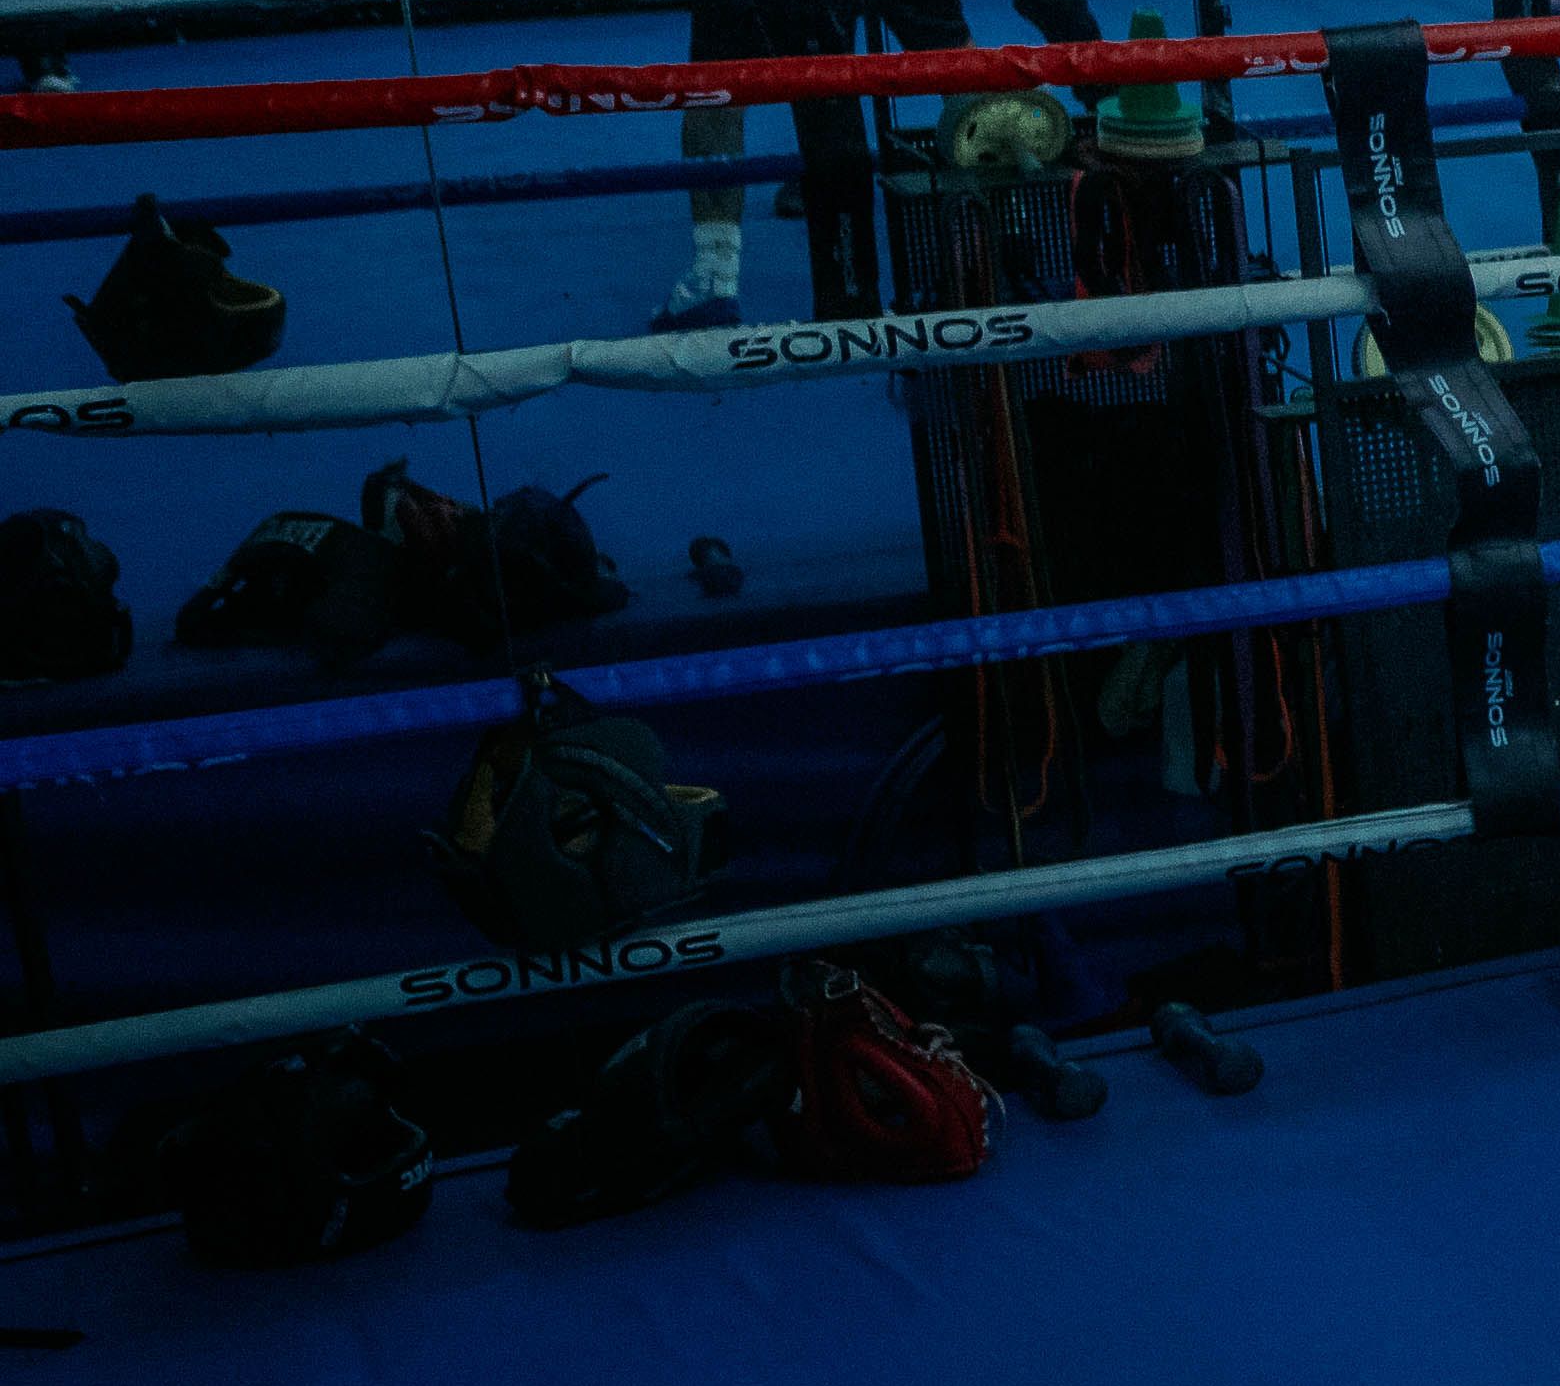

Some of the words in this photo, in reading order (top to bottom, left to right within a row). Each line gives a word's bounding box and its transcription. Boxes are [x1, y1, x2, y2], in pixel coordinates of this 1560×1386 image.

[1369, 112, 1406, 239] SONNOS
[728, 314, 1034, 370] SONNOS
[1428, 373, 1500, 487] SONNOS
[1485, 631, 1510, 747] SONNOS
[400, 931, 725, 1007] SONNOS
